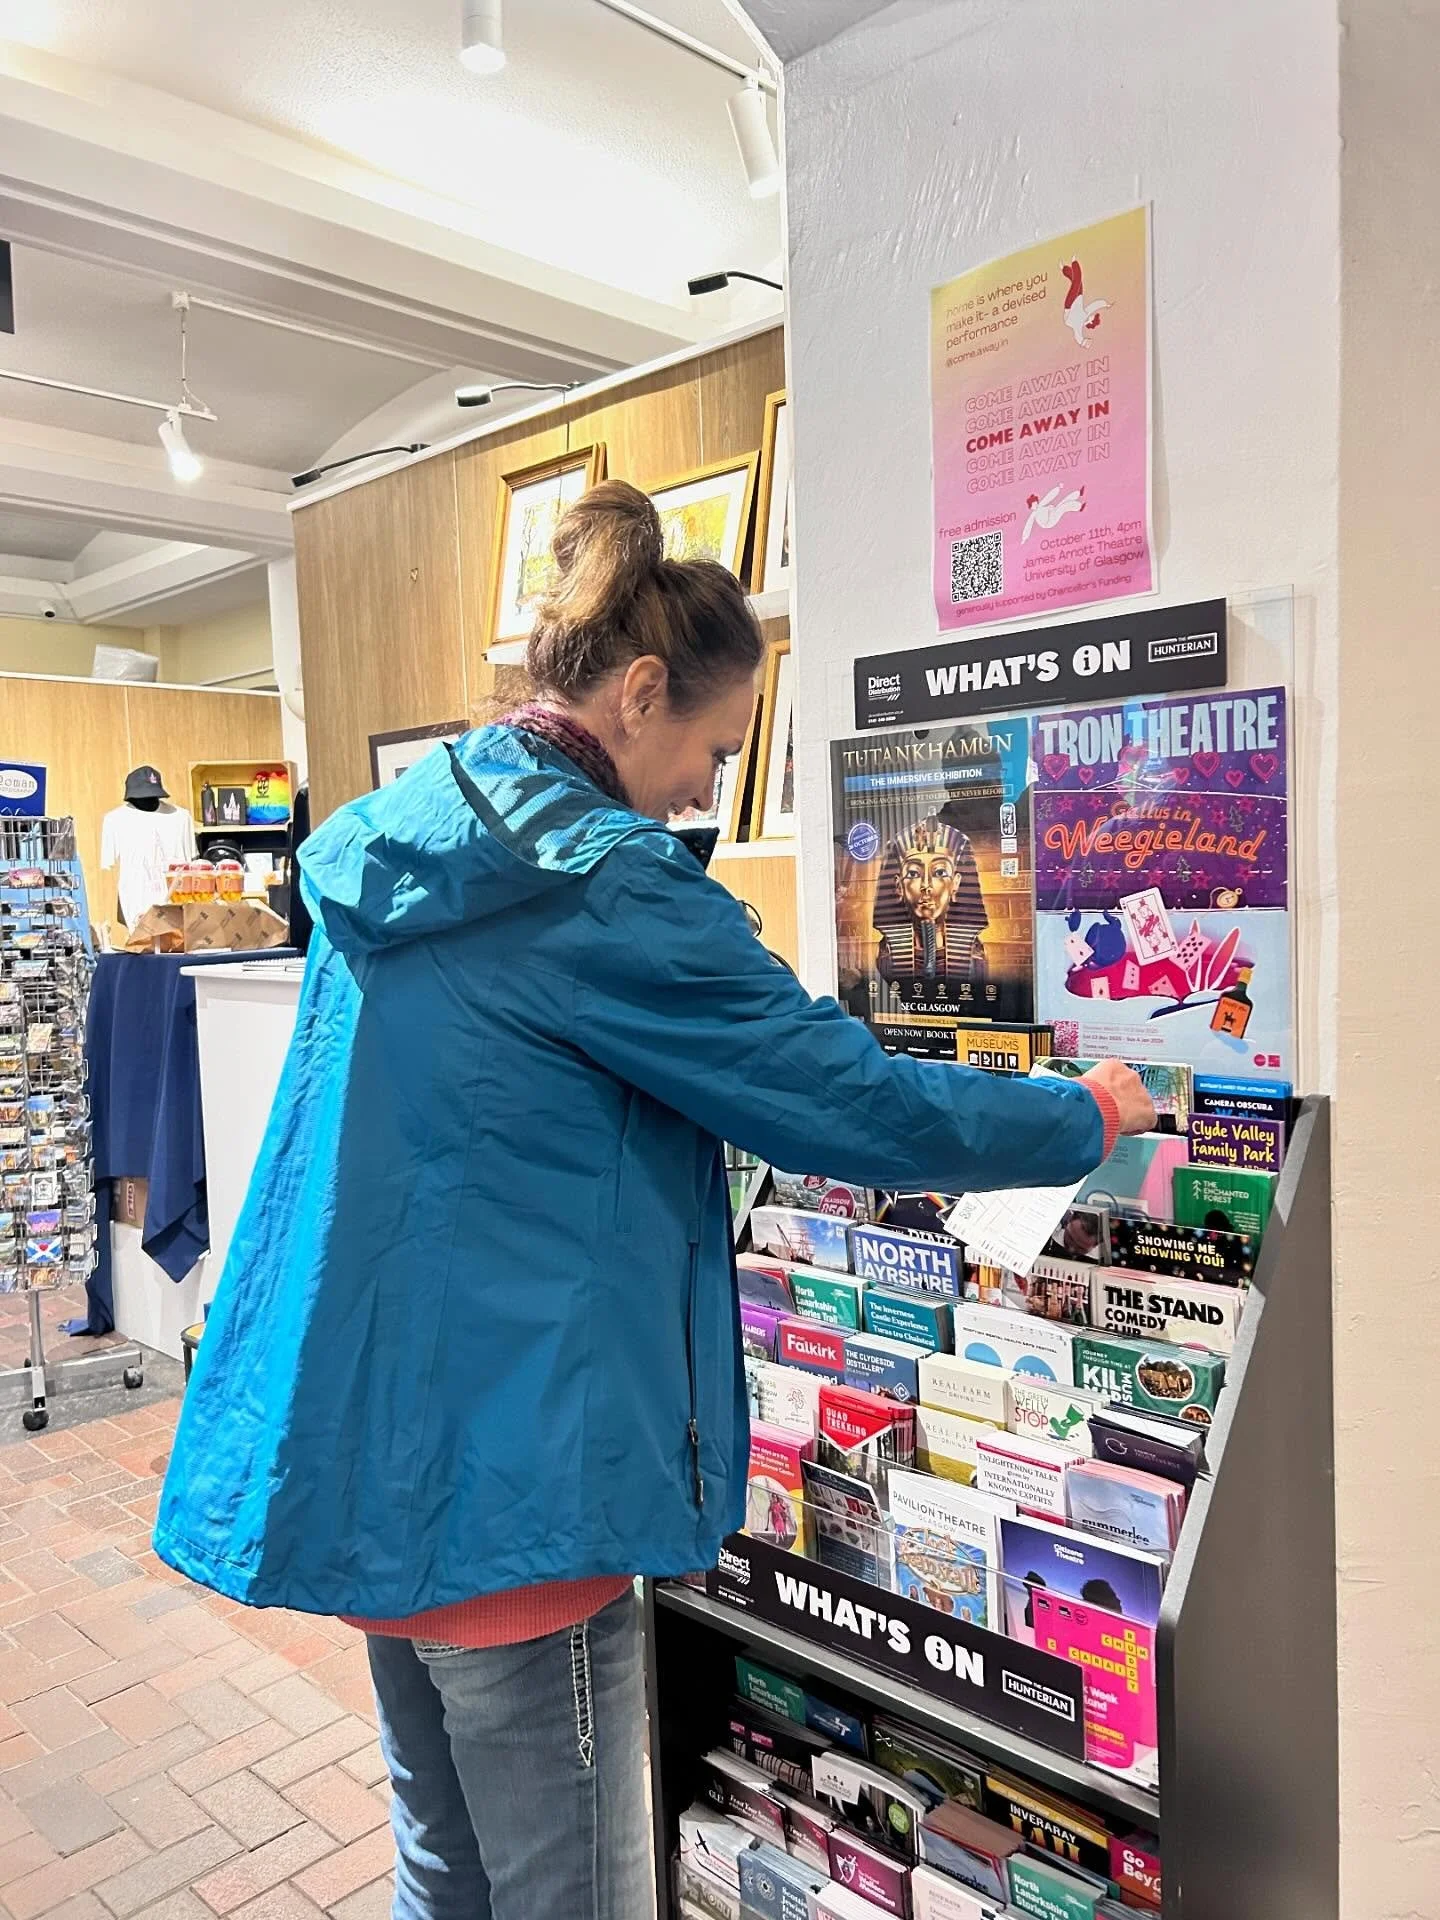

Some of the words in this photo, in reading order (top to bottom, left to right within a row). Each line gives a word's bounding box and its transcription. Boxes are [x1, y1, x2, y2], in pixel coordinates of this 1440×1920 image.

[976, 294, 985, 306] is
[987, 280, 1023, 302] where
[1026, 272, 1048, 291] you
[945, 314, 974, 333] make
[991, 307, 999, 317] a
[1002, 287, 1047, 313] devised
[945, 314, 1018, 350] performance
[964, 385, 1013, 413] COME
[1017, 364, 1081, 399] AWAY
[1086, 355, 1110, 378] IN
[965, 407, 1013, 433] COME
[1018, 386, 1081, 419] AWAY
[1086, 377, 1110, 398] IN
[965, 428, 1014, 454] COME
[1018, 408, 1081, 440] AWAY
[1087, 399, 1110, 419] IN
[966, 448, 1014, 474] COME
[1018, 428, 1082, 460] AWAY
[1087, 421, 1110, 441] IN
[966, 468, 1015, 494] COME
[1018, 448, 1082, 481] AWAY
[1087, 442, 1110, 461] IN
[938, 523, 962, 539] free
[964, 509, 1017, 534] admission
[1039, 530, 1086, 552] October
[1087, 525, 1115, 541] 11th,
[1116, 519, 1142, 536] 4pm
[1022, 550, 1057, 570] James
[1057, 542, 1095, 562] Arnott
[1097, 535, 1143, 553] Theatre
[1023, 561, 1078, 583] University
[1078, 556, 1091, 571] of
[1093, 549, 1145, 571] Glasgow
[955, 603, 994, 617] generously
[994, 592, 1034, 611] supported
[1035, 589, 1046, 602] by
[1097, 573, 1132, 590] Funding
[1153, 638, 1212, 657] HUNTERIAN
[924, 651, 1060, 698] WHAT'S
[1071, 638, 1132, 677] ON
[868, 673, 901, 690] Direct
[868, 685, 901, 696] Distribution
[1038, 713, 1123, 768] TRON
[1127, 695, 1279, 760] THEATRE
[843, 733, 1014, 770] TUTANKHAMUN
[870, 777, 887, 788] THE
[886, 772, 934, 786] IMMERSIVE
[934, 767, 983, 782] EXHIBITION
[962, 788, 982, 798] NEVER
[983, 786, 1006, 796] BEFORE
[1110, 799, 1170, 820] Gallus
[1172, 806, 1191, 822] in
[1044, 814, 1268, 870] Weegieland
[901, 1002, 917, 1012] SEC
[917, 1002, 961, 1013] GLASGOW
[884, 1027, 904, 1037] OPEN
[903, 1028, 923, 1038] NOW
[926, 1030, 945, 1039] BOOK
[966, 1037, 1020, 1051] MUSEUMS
[1204, 1098, 1236, 1108] CAMERA
[1236, 1101, 1274, 1111] OBSCURA
[1191, 1120, 1228, 1140] Clyde
[1231, 1123, 1275, 1147] Valley
[1192, 1138, 1238, 1163] Family
[1243, 1144, 1275, 1163] Park
[1203, 1180, 1217, 1188] THE
[1203, 1187, 1250, 1199] ENCHANTED
[1203, 1194, 1232, 1205] FOREST
[1137, 1234, 1195, 1251] SNOWING
[862, 1237, 951, 1276] NORTH
[1133, 1244, 1191, 1262] SNOWING
[1194, 1253, 1226, 1269] YOU!
[863, 1261, 954, 1295] AYRSHIRE
[795, 1284, 815, 1298] North
[796, 1295, 838, 1314] Lanarkshire
[797, 1306, 821, 1319] Stories
[822, 1311, 838, 1324] Trail
[869, 1301, 882, 1312] The
[882, 1304, 916, 1320] Inverness
[1103, 1285, 1144, 1311] THE
[1148, 1293, 1225, 1326] STAND
[870, 1311, 891, 1324] Castle
[891, 1316, 929, 1332] Experience
[1104, 1307, 1168, 1332] COMEDY
[787, 1333, 838, 1361] Falkirk
[844, 1348, 859, 1359] THE
[859, 1352, 896, 1369] CLYDESIDE
[1082, 1349, 1108, 1359] JOURNEY
[846, 1358, 885, 1375] DISTILLERY
[1082, 1362, 1122, 1391] KIL
[932, 1377, 958, 1391] REAL
[962, 1385, 992, 1400] FARM
[1014, 1387, 1025, 1396] THE
[1027, 1391, 1049, 1403] GREEN
[826, 1407, 848, 1421] QUAD
[1014, 1394, 1049, 1416] WELLY
[826, 1417, 868, 1437] TREKKING
[1014, 1406, 1049, 1430] STOP
[925, 1422, 949, 1436] REAL
[955, 1431, 975, 1444] FAR
[979, 1453, 1034, 1476] ENLIGHTENING
[1034, 1469, 1059, 1483] TALKS
[984, 1470, 1056, 1498] INTERNATIONALLY
[988, 1481, 1018, 1495] KNOWN
[1018, 1490, 1053, 1506] EXPERTS
[893, 1490, 936, 1518] PAVILION
[937, 1510, 987, 1537] THEATRE
[918, 1514, 956, 1533] GLASGOW
[719, 1547, 751, 1571] Direct
[1053, 1543, 1084, 1558] Citizens
[1056, 1550, 1085, 1565] Theatre
[718, 1558, 751, 1579] Distribution
[774, 1571, 912, 1654] WHAT'S
[924, 1634, 985, 1688] ON
[1103, 1634, 1148, 1658] CHUM
[1008, 1678, 1069, 1712] HUNTERIAN
[1089, 1686, 1119, 1705] Week
[1010, 1803, 1077, 1844] INVERARAY
[1122, 1849, 1145, 1868] Go
[1013, 1873, 1040, 1894] North
[1014, 1883, 1069, 1920] Lanarkshire
[1016, 1895, 1048, 1920] Stories
